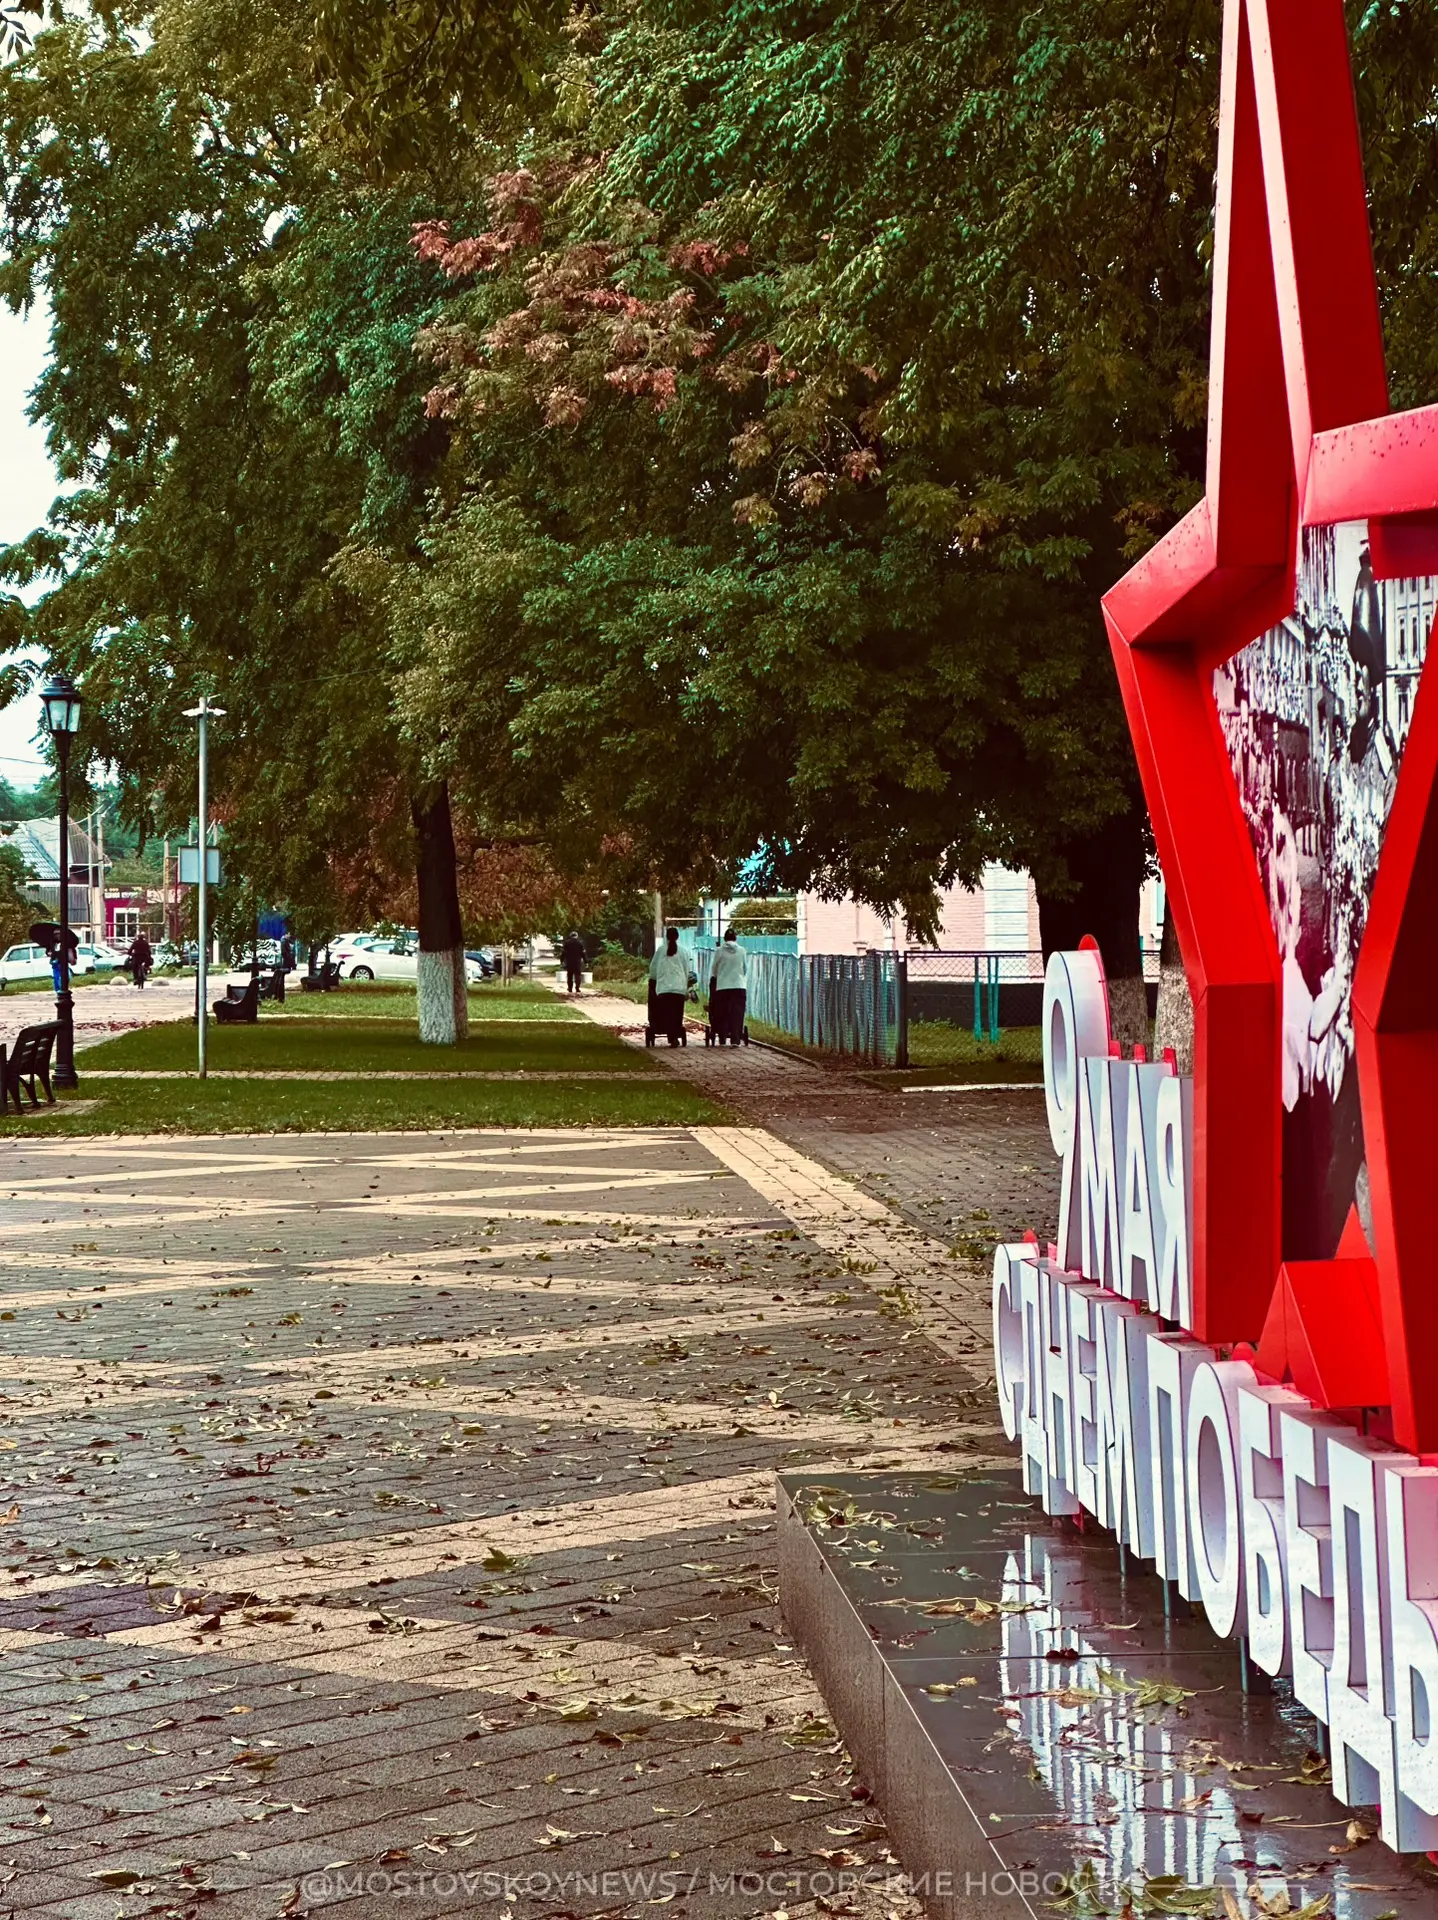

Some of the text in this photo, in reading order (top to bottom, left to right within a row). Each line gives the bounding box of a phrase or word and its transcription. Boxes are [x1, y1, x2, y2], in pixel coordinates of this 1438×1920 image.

[1042, 951, 1194, 1332] 9 МАЯ
[992, 1244, 1022, 1441] С
